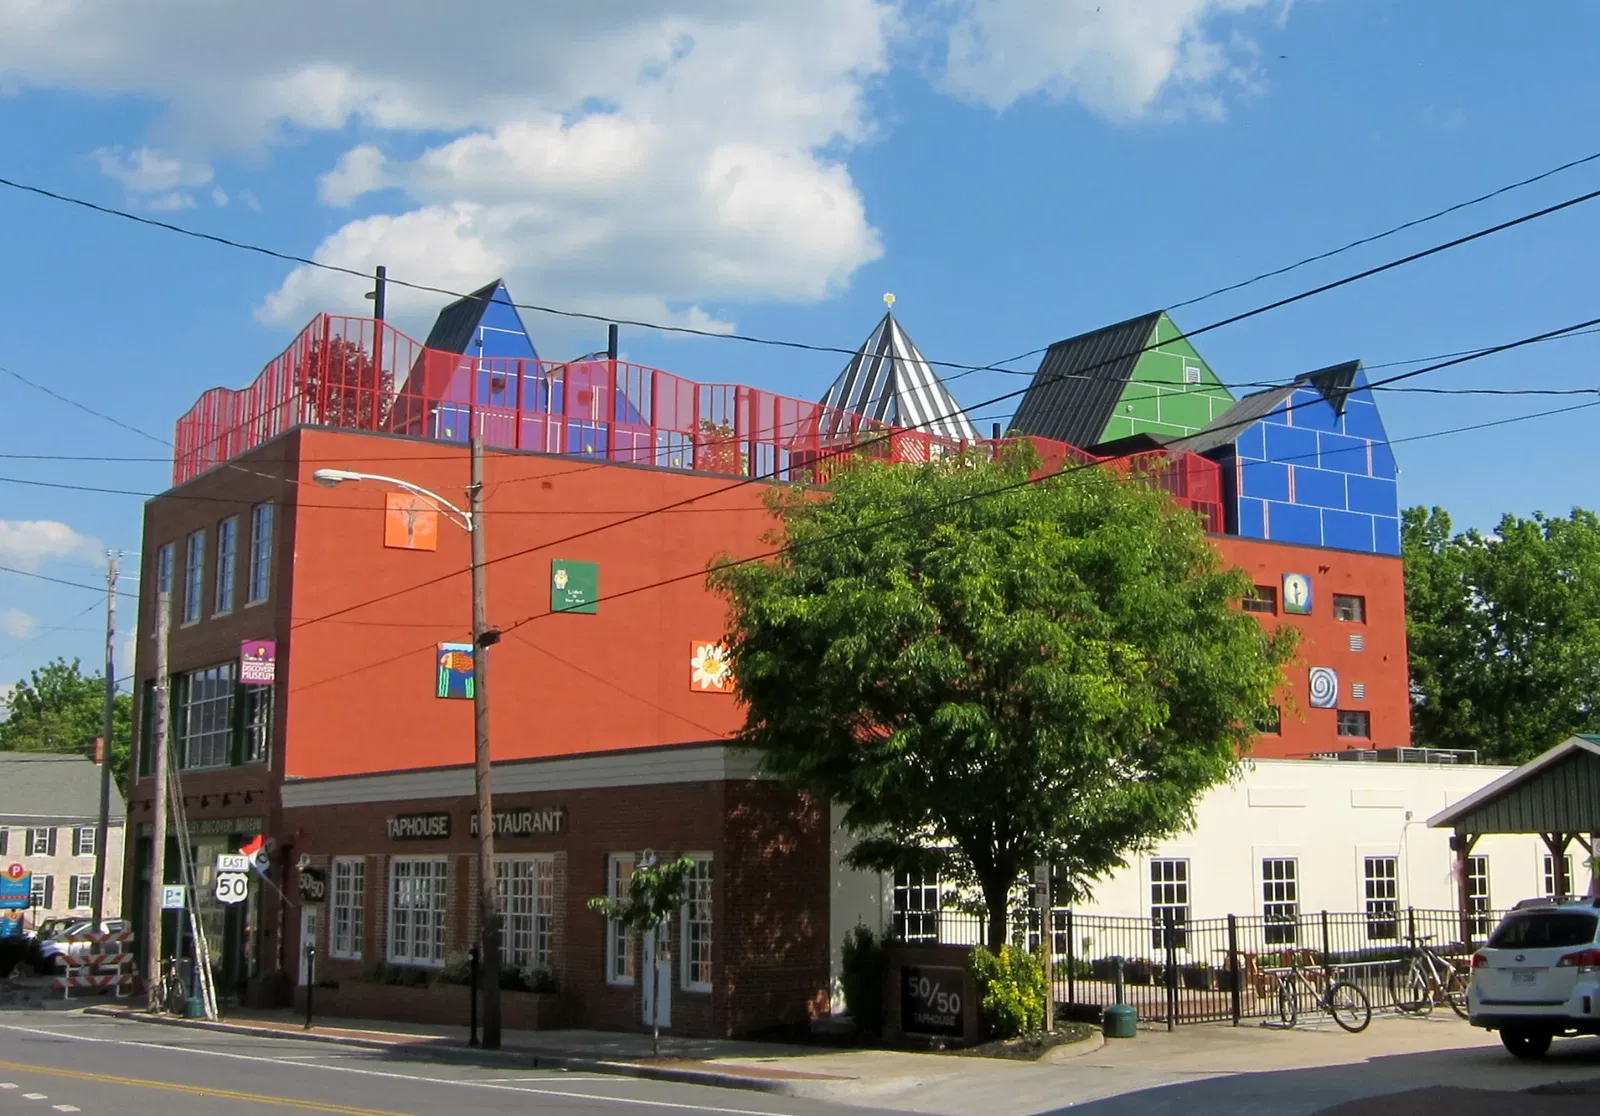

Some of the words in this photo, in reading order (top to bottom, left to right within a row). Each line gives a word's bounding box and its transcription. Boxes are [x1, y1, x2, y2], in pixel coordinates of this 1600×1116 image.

[241, 671, 275, 681] MUSEUM
[387, 816, 448, 837] TAPHOUSE
[470, 811, 563, 834] RSTAURANT
[222, 857, 245, 869] EAST
[12, 865, 20, 877] P
[219, 878, 246, 897] 50
[165, 889, 173, 900] P
[908, 976, 961, 1014] 50/50
